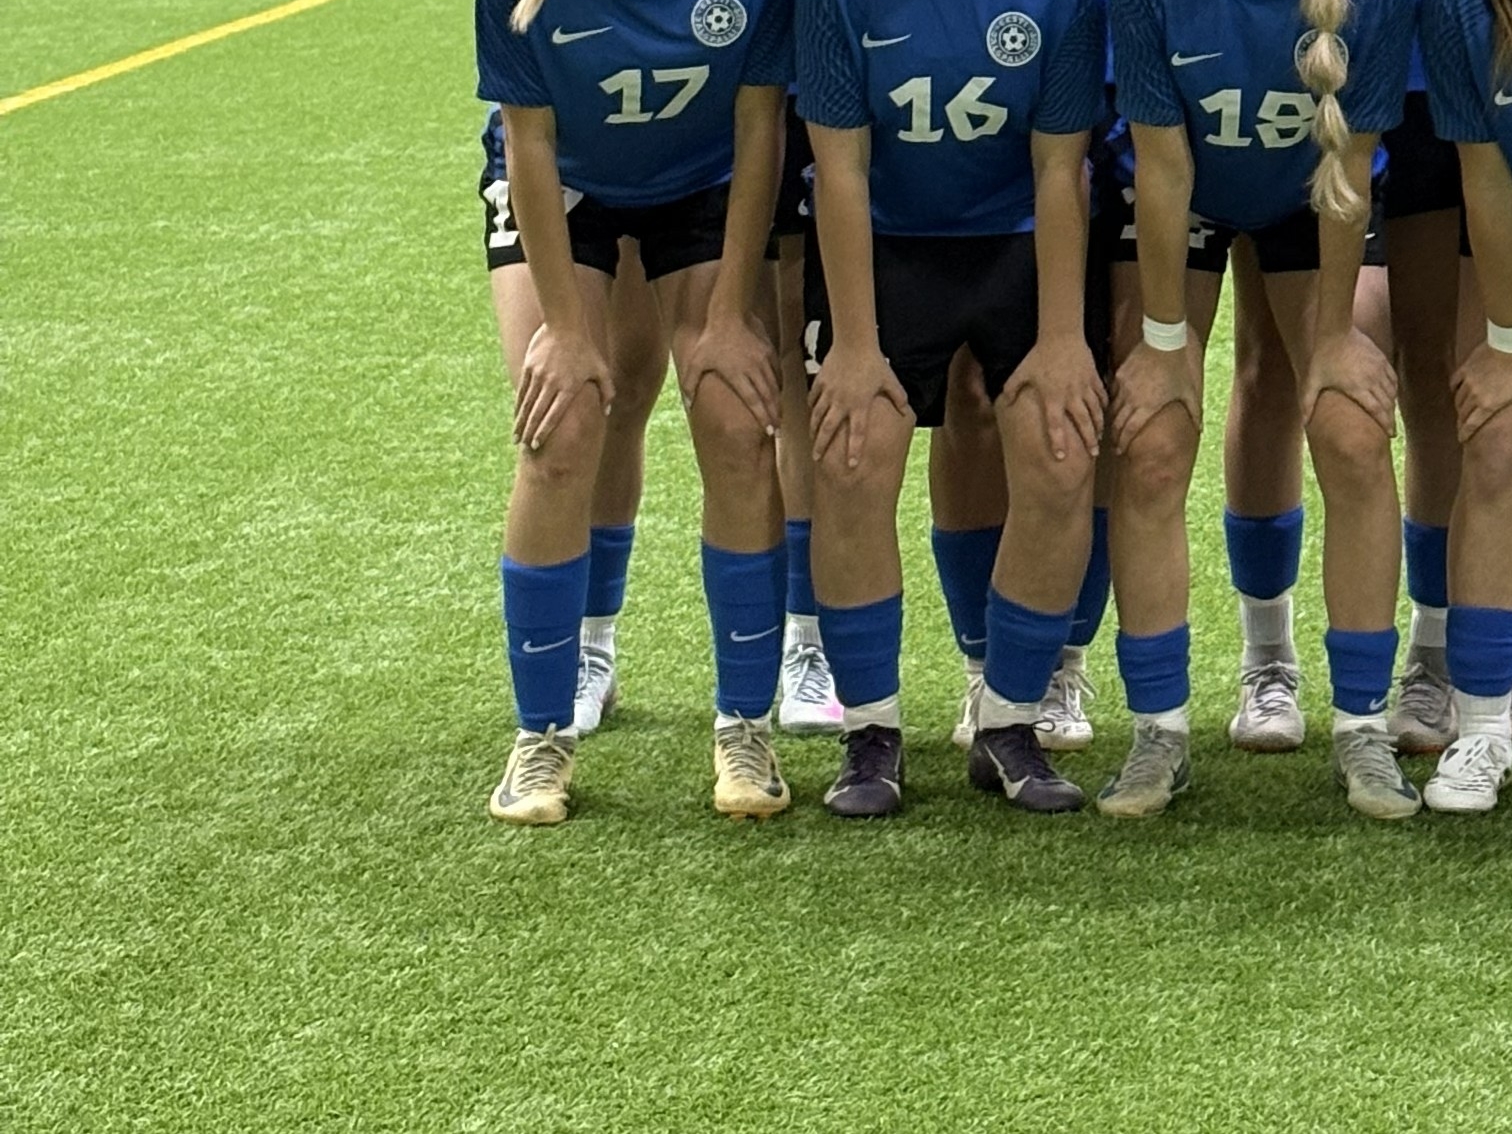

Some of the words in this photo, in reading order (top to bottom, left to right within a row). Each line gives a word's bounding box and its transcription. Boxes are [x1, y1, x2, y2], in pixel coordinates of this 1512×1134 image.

[599, 65, 710, 124] 17
[889, 76, 1008, 143] 16
[1198, 88, 1317, 148] 18
